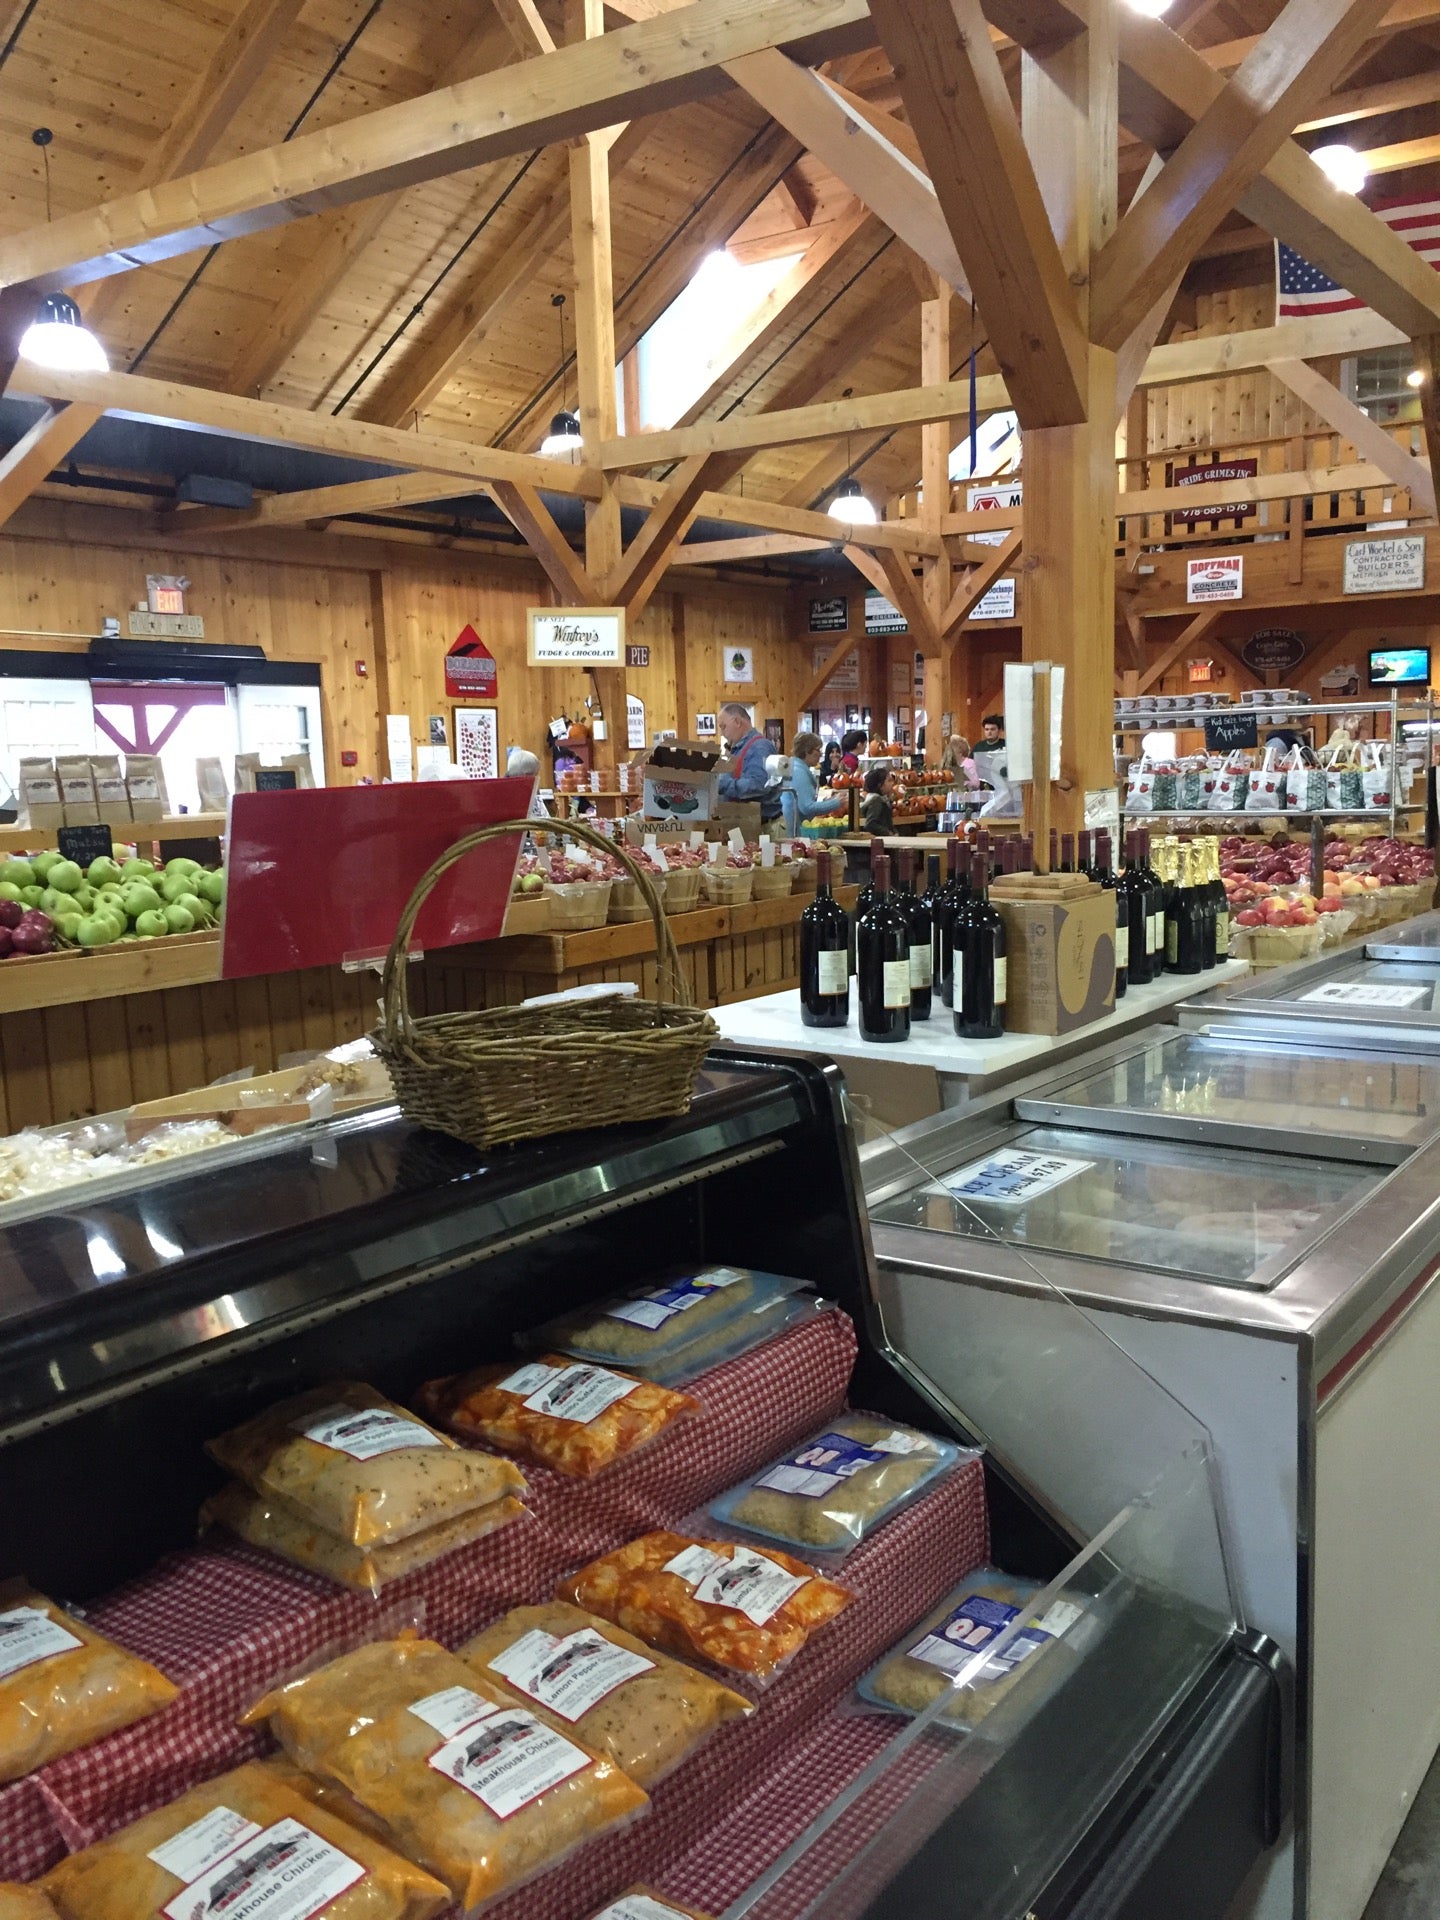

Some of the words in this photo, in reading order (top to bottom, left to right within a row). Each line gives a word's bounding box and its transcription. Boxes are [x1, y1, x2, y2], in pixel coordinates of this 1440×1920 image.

[1204, 468, 1236, 480] GRIMES
[1404, 540, 1421, 551] Son
[1353, 553, 1415, 564] CONTRACTORS
[1357, 561, 1410, 572] BUILDERS
[1190, 559, 1240, 576] HOFFMAN
[1194, 580, 1236, 589] CONCRETE
[158, 592, 178, 611] EXIT
[552, 624, 600, 647] Winfrey's
[630, 647, 648, 666] PIE
[1192, 667, 1209, 679] EXIT
[1210, 716, 1223, 726] Kid
[1215, 724, 1247, 741] Apples
[637, 822, 686, 834] TURBANA
[957, 1178, 993, 1195] ICE
[978, 1154, 1042, 1179] CREAM
[731, 1583, 752, 1606] Jumbo
[545, 1679, 574, 1704] Lemon
[573, 1660, 600, 1681] Pepper
[471, 1751, 527, 1792] Steakhouse
[525, 1735, 561, 1756] Chicken
[281, 1847, 331, 1883] Chicken
